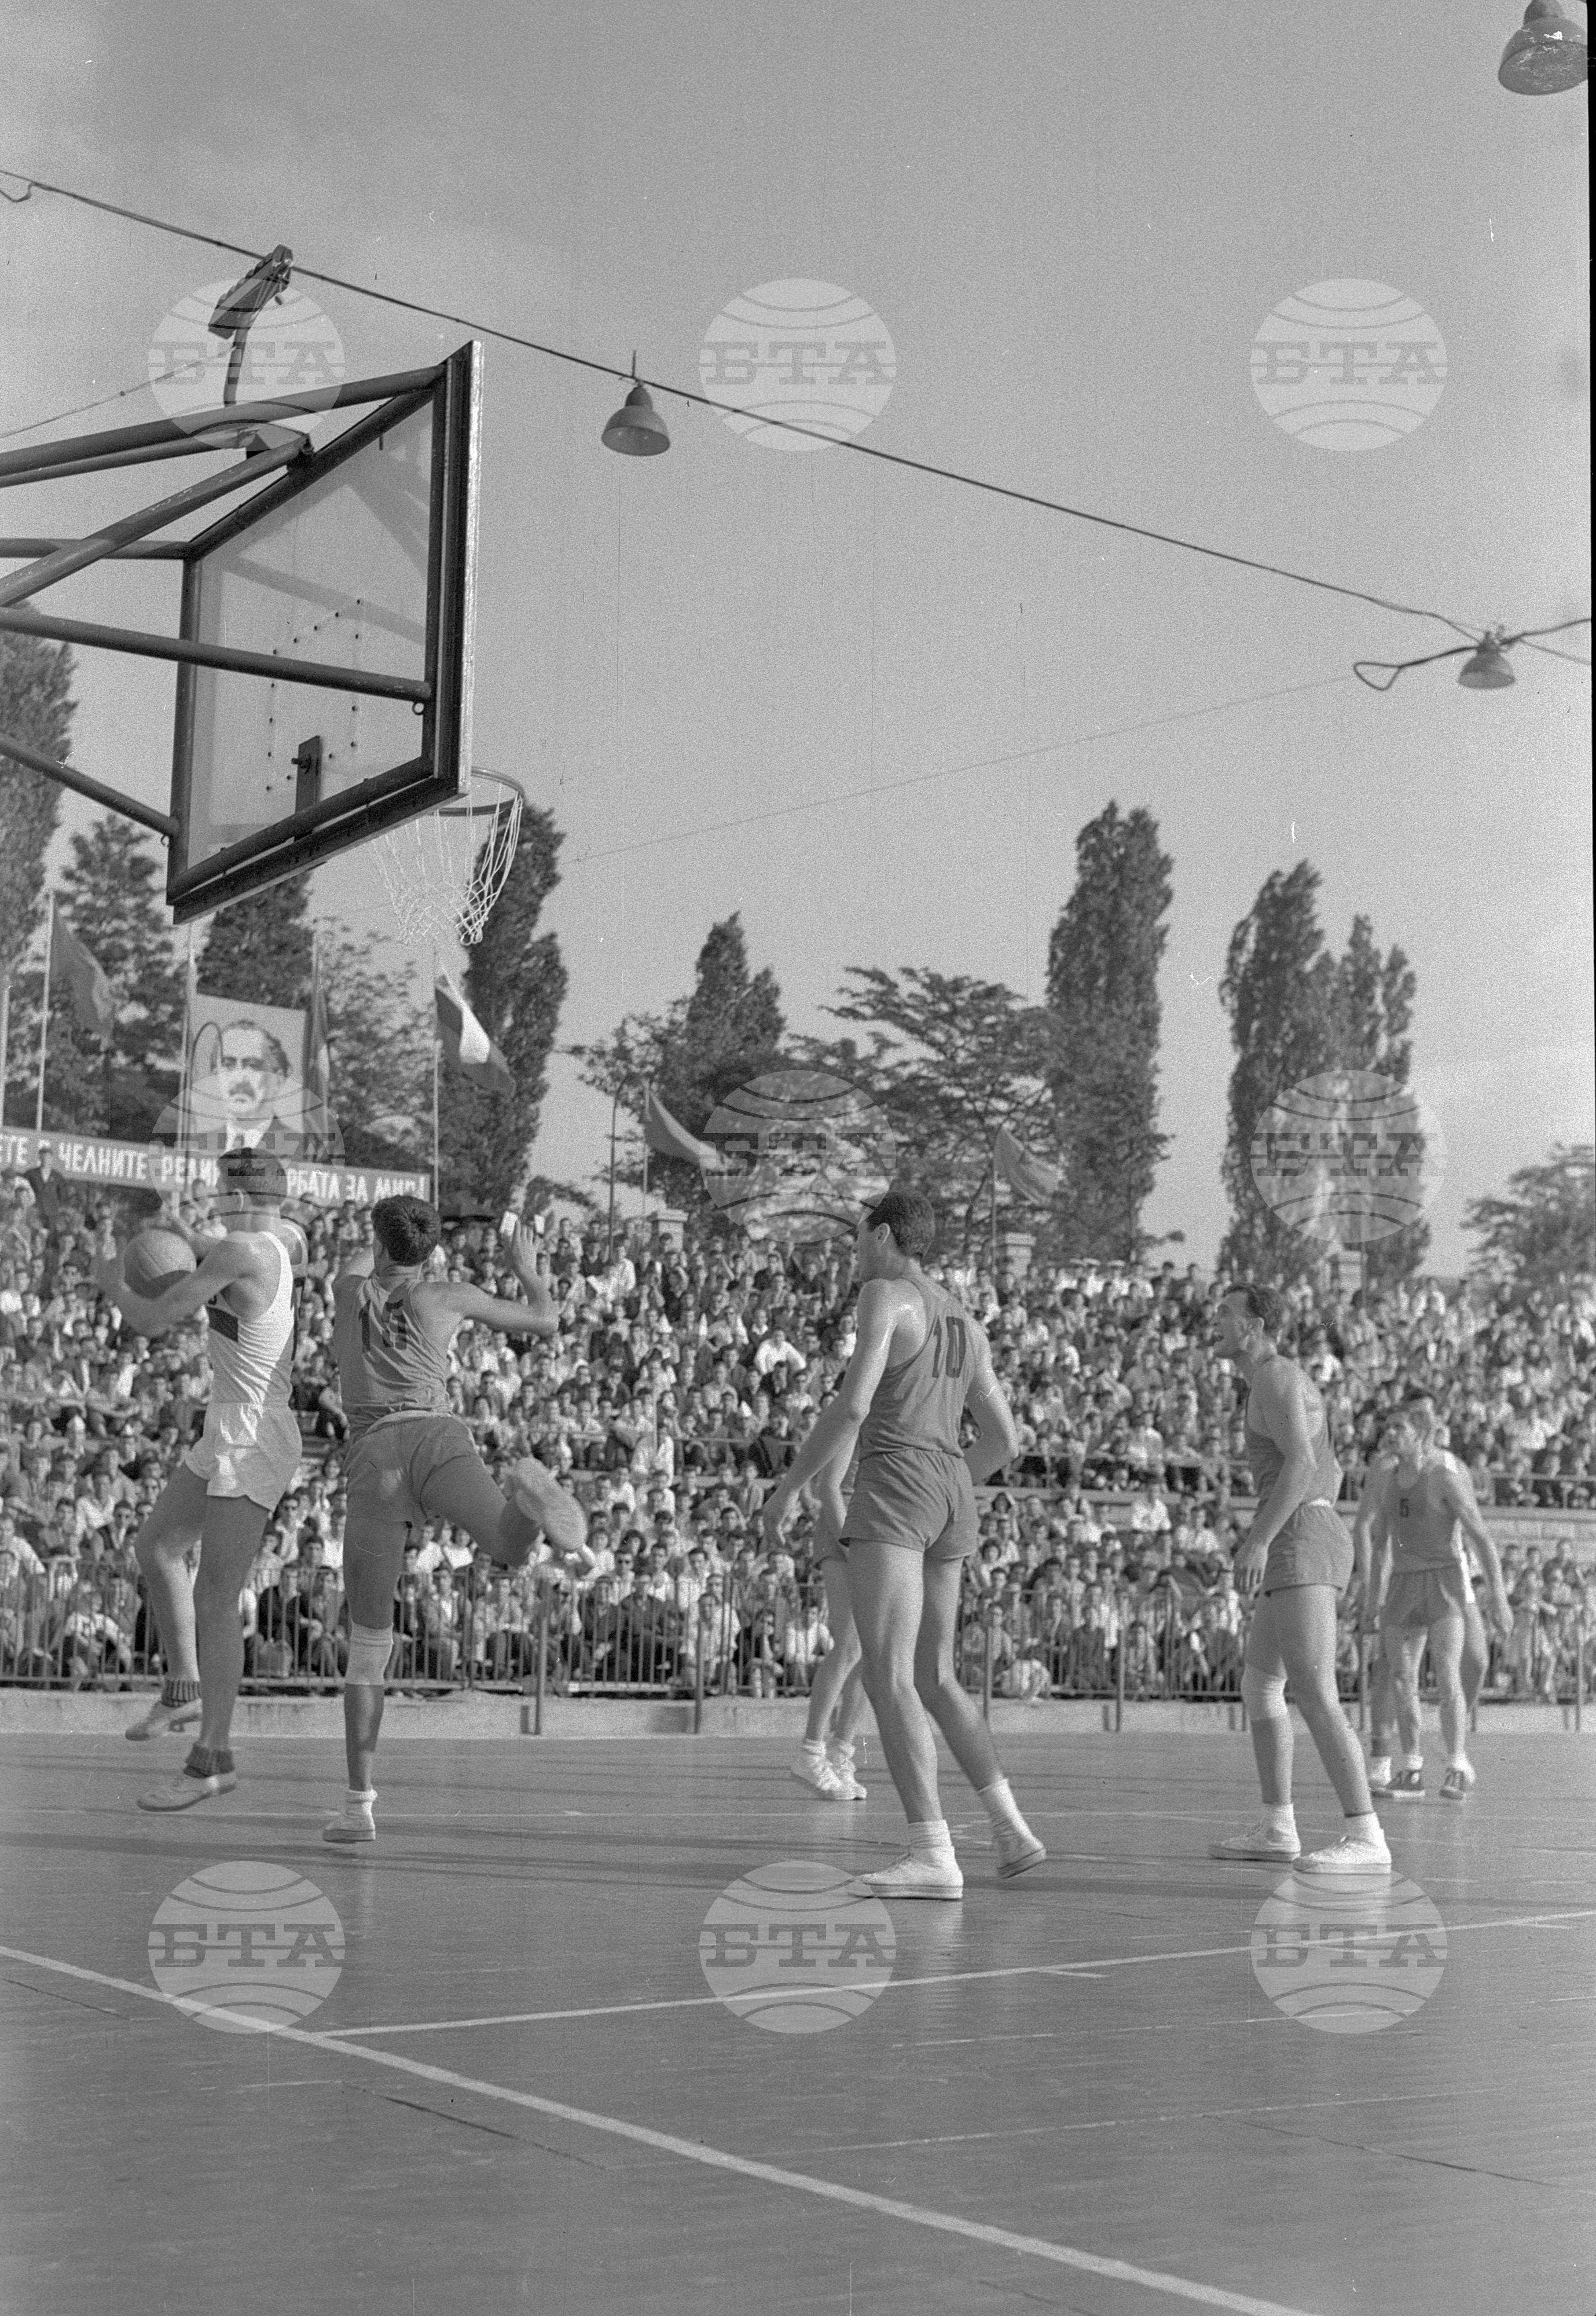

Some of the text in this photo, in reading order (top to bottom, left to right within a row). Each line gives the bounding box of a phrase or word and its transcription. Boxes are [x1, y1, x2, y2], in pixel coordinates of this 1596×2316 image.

[58, 1141, 148, 1180] ЧЕЛНИТЕ
[287, 1168, 340, 1199] РБАТА
[346, 1174, 369, 1203] ЗА
[931, 1314, 966, 1379] 10
